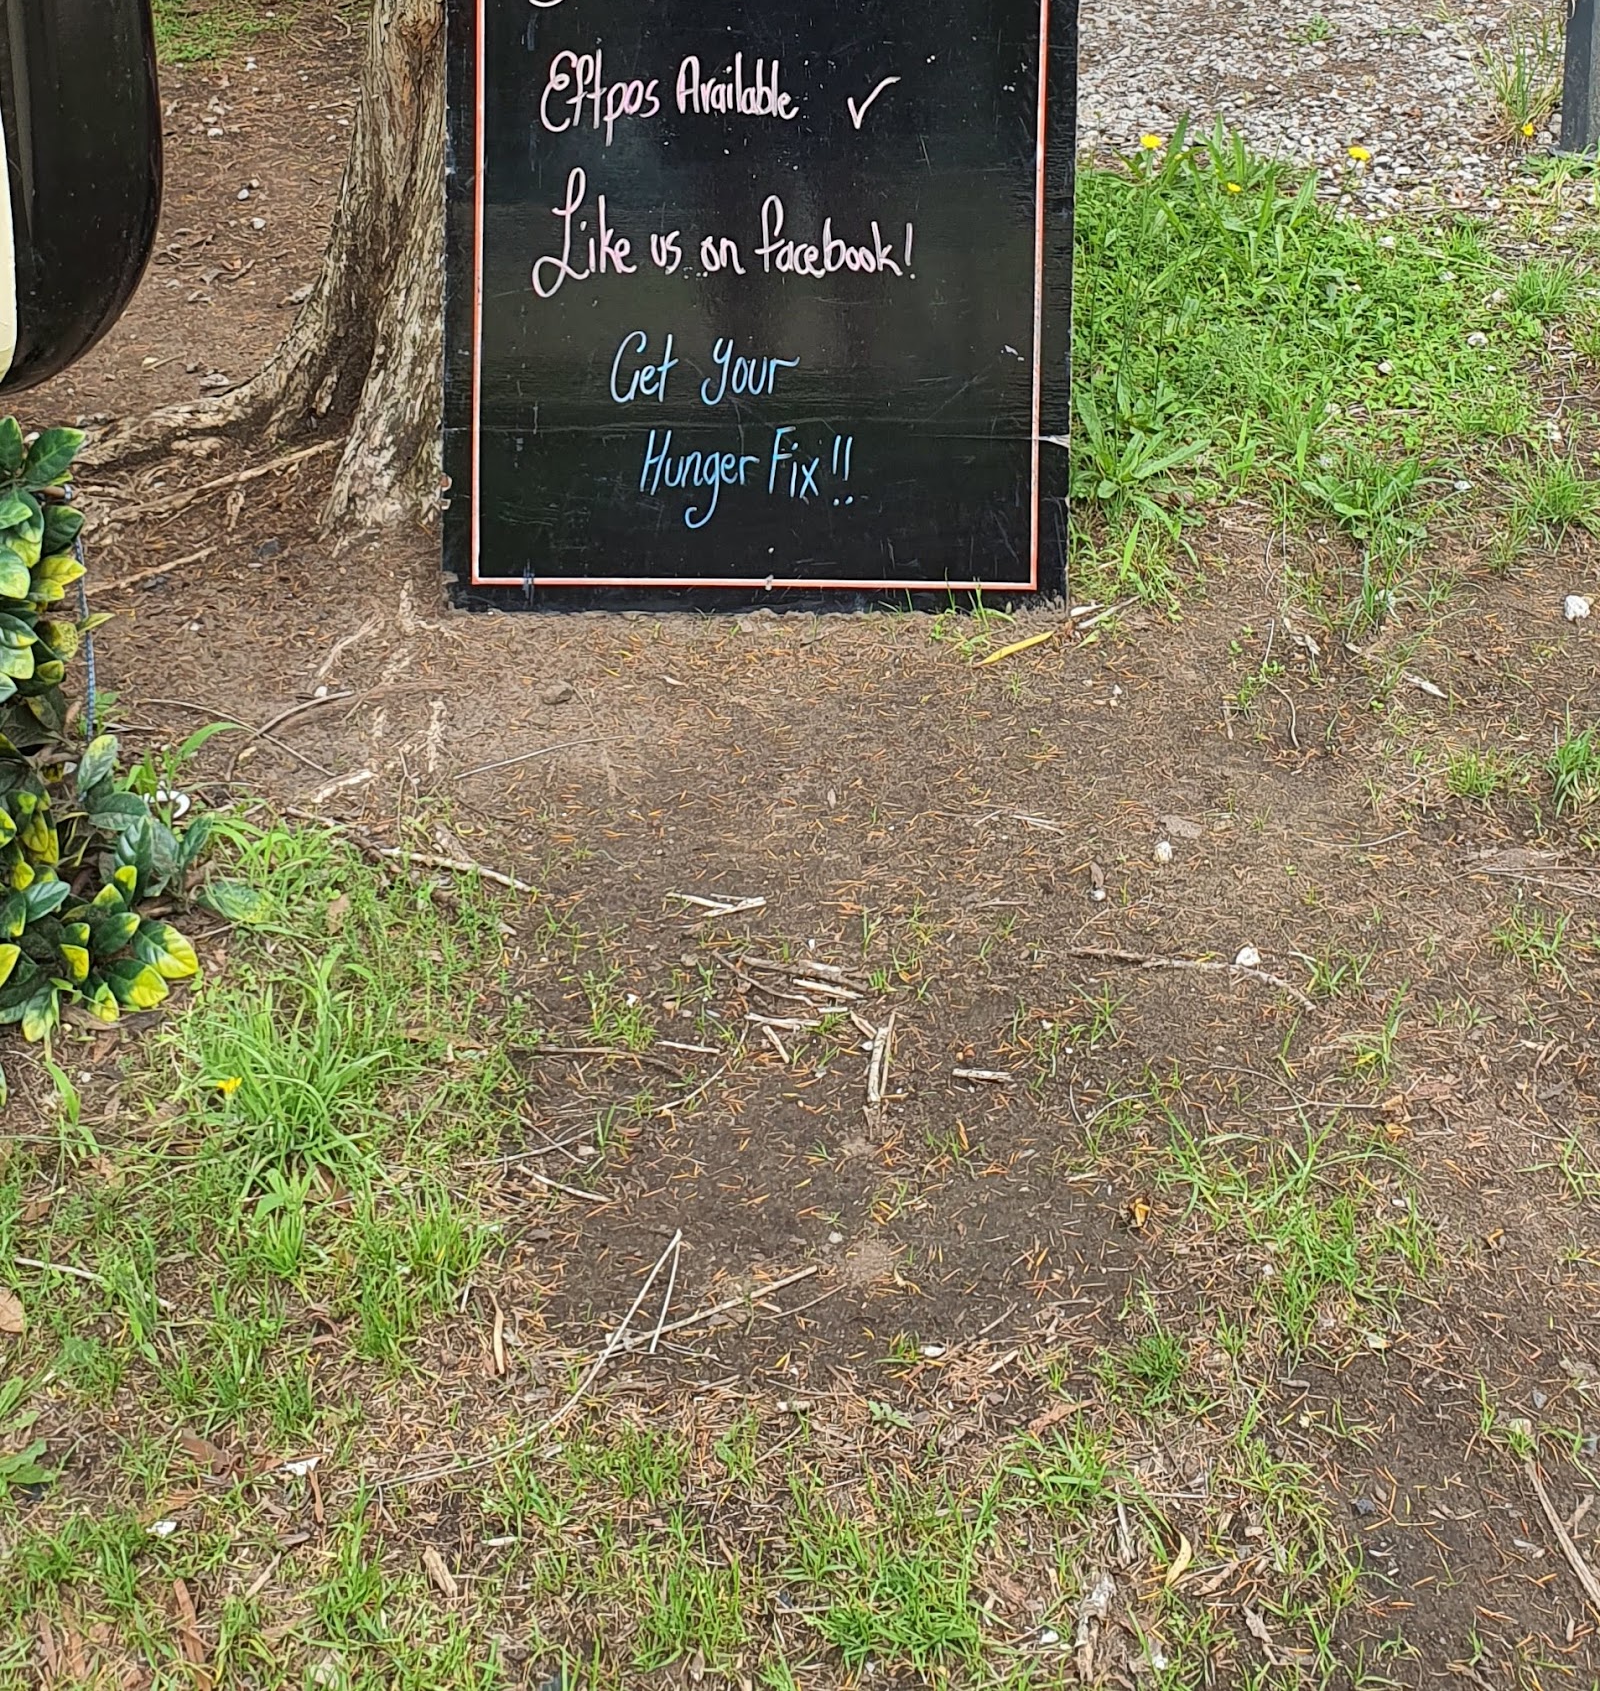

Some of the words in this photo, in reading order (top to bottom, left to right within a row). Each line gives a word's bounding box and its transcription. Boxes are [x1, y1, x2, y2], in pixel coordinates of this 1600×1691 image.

[540, 51, 660, 147] Eftpos
[677, 52, 799, 120] Available
[532, 166, 637, 298] Like
[650, 231, 682, 276] us
[700, 233, 747, 277] on
[755, 195, 916, 280] facebook!
[610, 330, 678, 404] Get
[640, 429, 760, 529] Hunger
